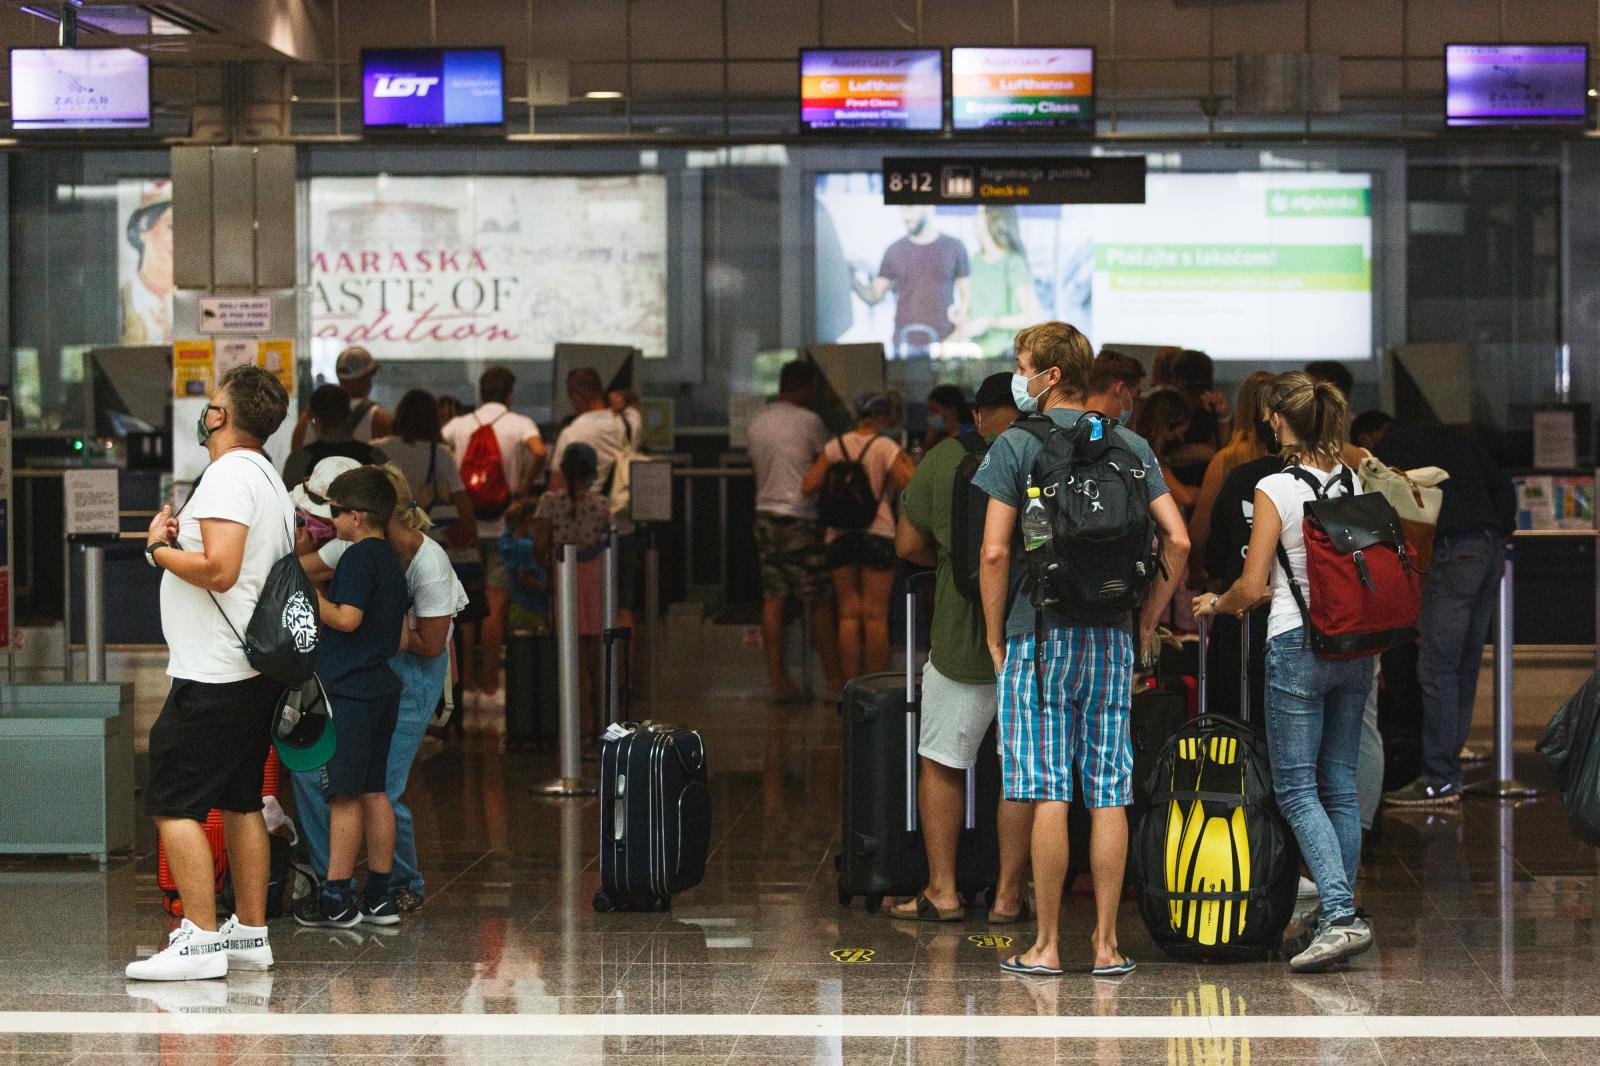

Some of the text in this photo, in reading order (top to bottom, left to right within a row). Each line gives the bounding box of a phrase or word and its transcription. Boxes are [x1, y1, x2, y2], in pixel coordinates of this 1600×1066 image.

[373, 77, 439, 97] LOT
[889, 172, 933, 193] 8-12
[979, 184, 1030, 197] Check-in
[311, 276, 519, 314] ASTE OF
[311, 303, 519, 344] adition
[190, 943, 215, 955] BIG STAR
[230, 939, 240, 950] BIG
[240, 938, 255, 949] STAR
